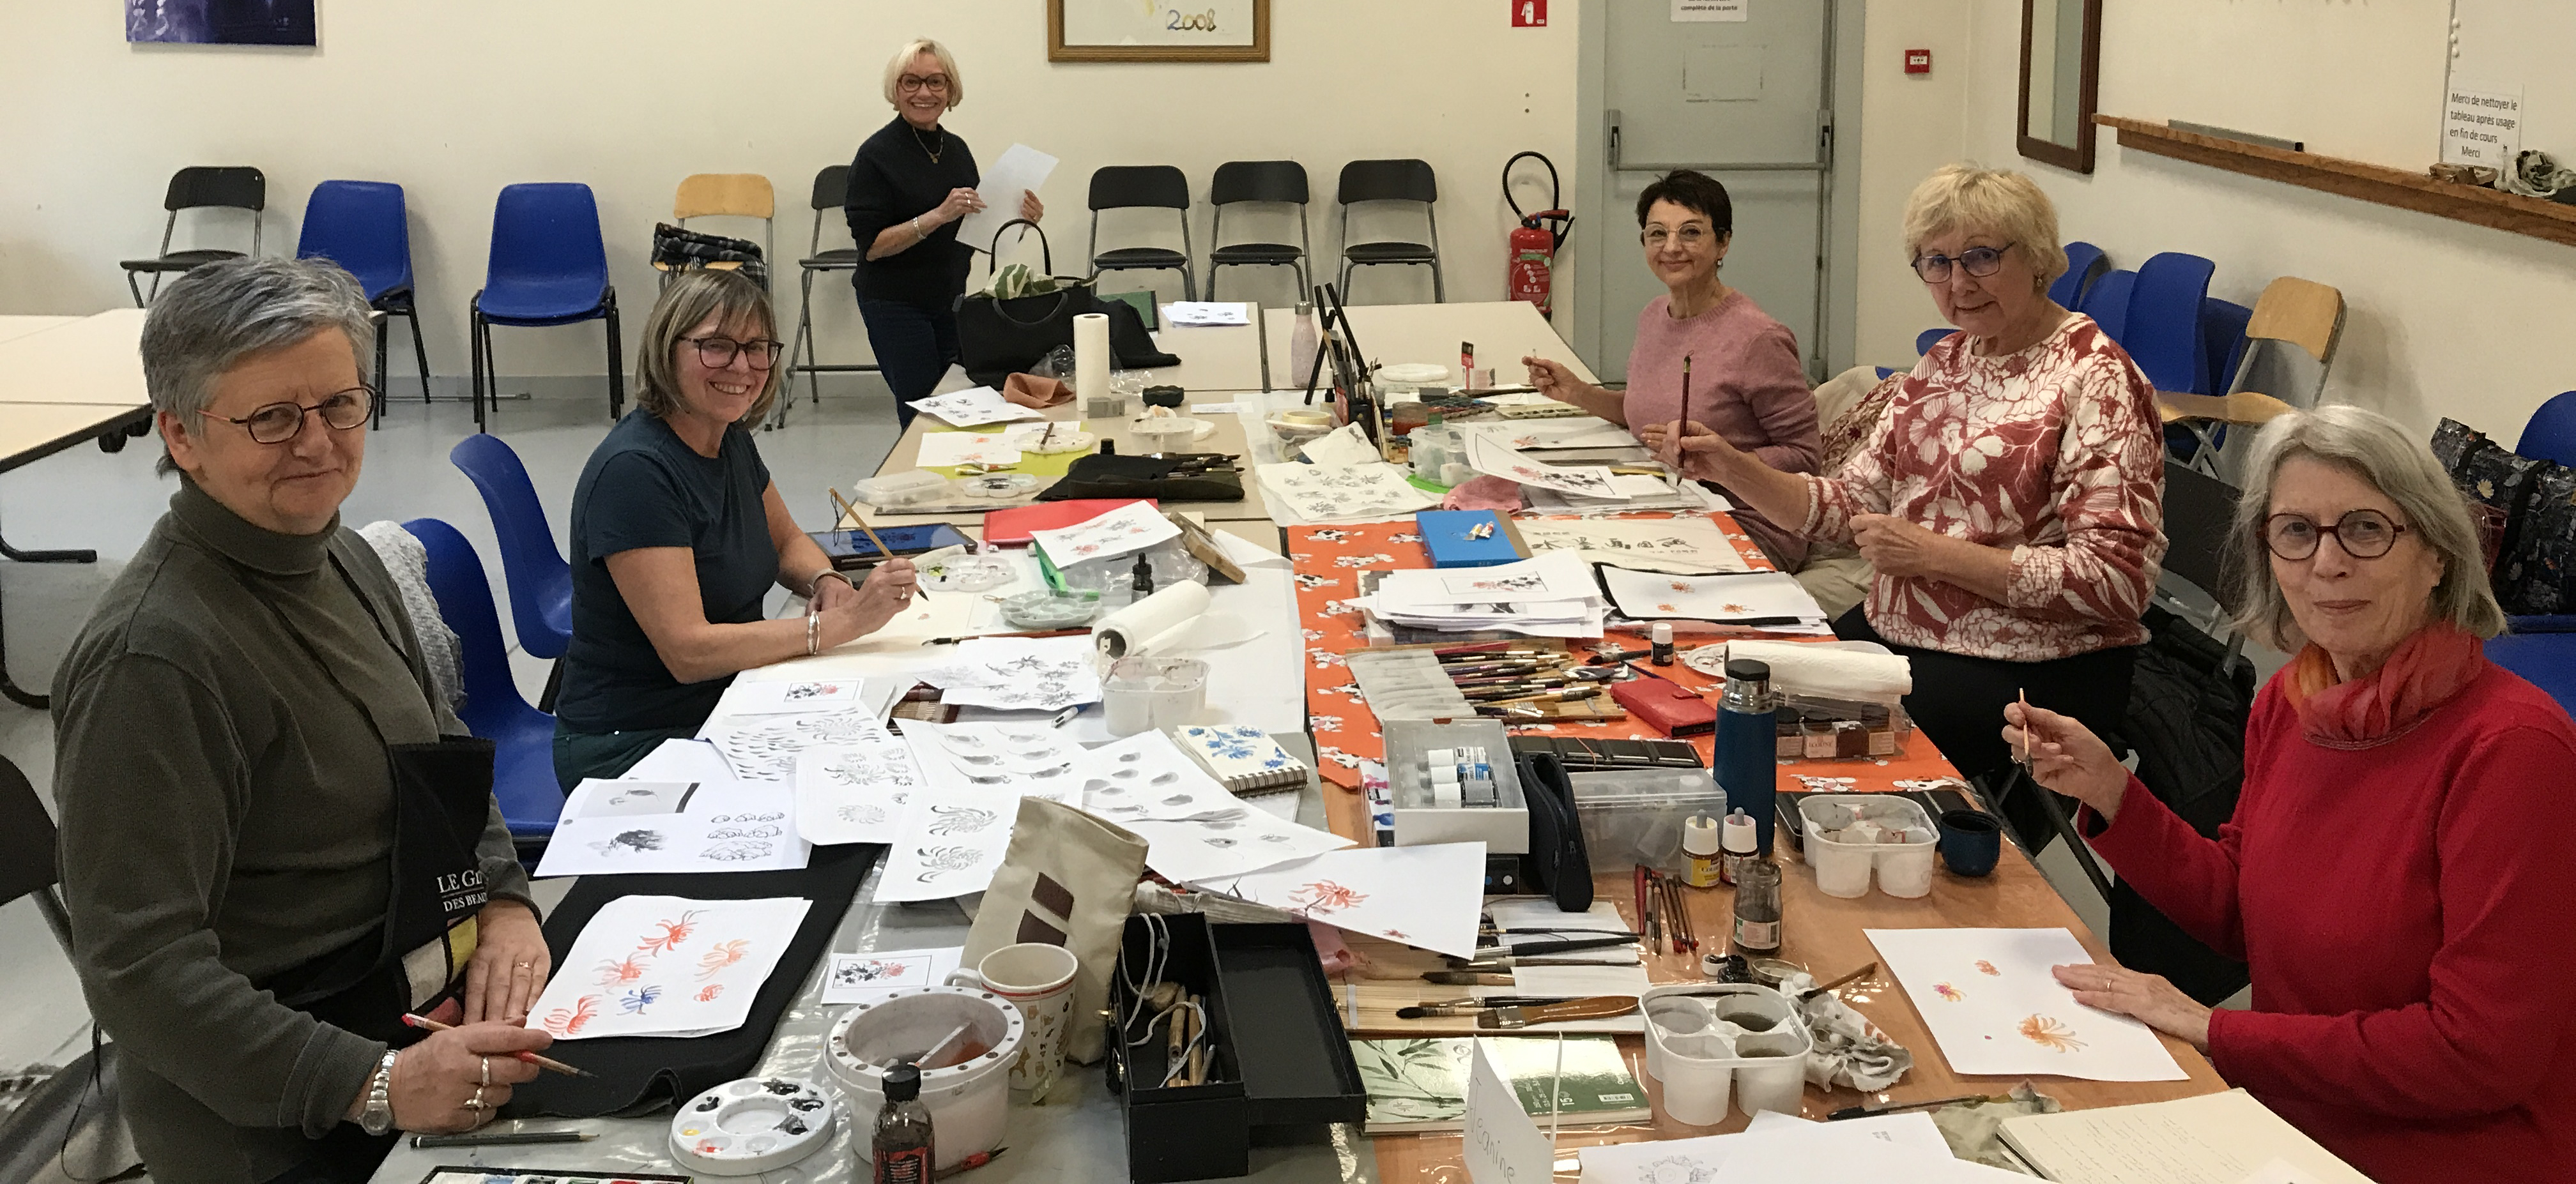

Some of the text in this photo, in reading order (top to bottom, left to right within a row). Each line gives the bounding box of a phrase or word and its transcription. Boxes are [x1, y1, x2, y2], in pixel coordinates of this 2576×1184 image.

[1166, 8, 1216, 32] 2008
[2451, 93, 2517, 110] Merci de nettoyer le
[2450, 110, 2515, 130] tableau après usage
[2450, 128, 2498, 144] en fin de cours
[2461, 146, 2481, 158] Merci
[436, 873, 460, 893] LE
[443, 897, 465, 913] DES
[1470, 1077, 1515, 1184] Jeanine
